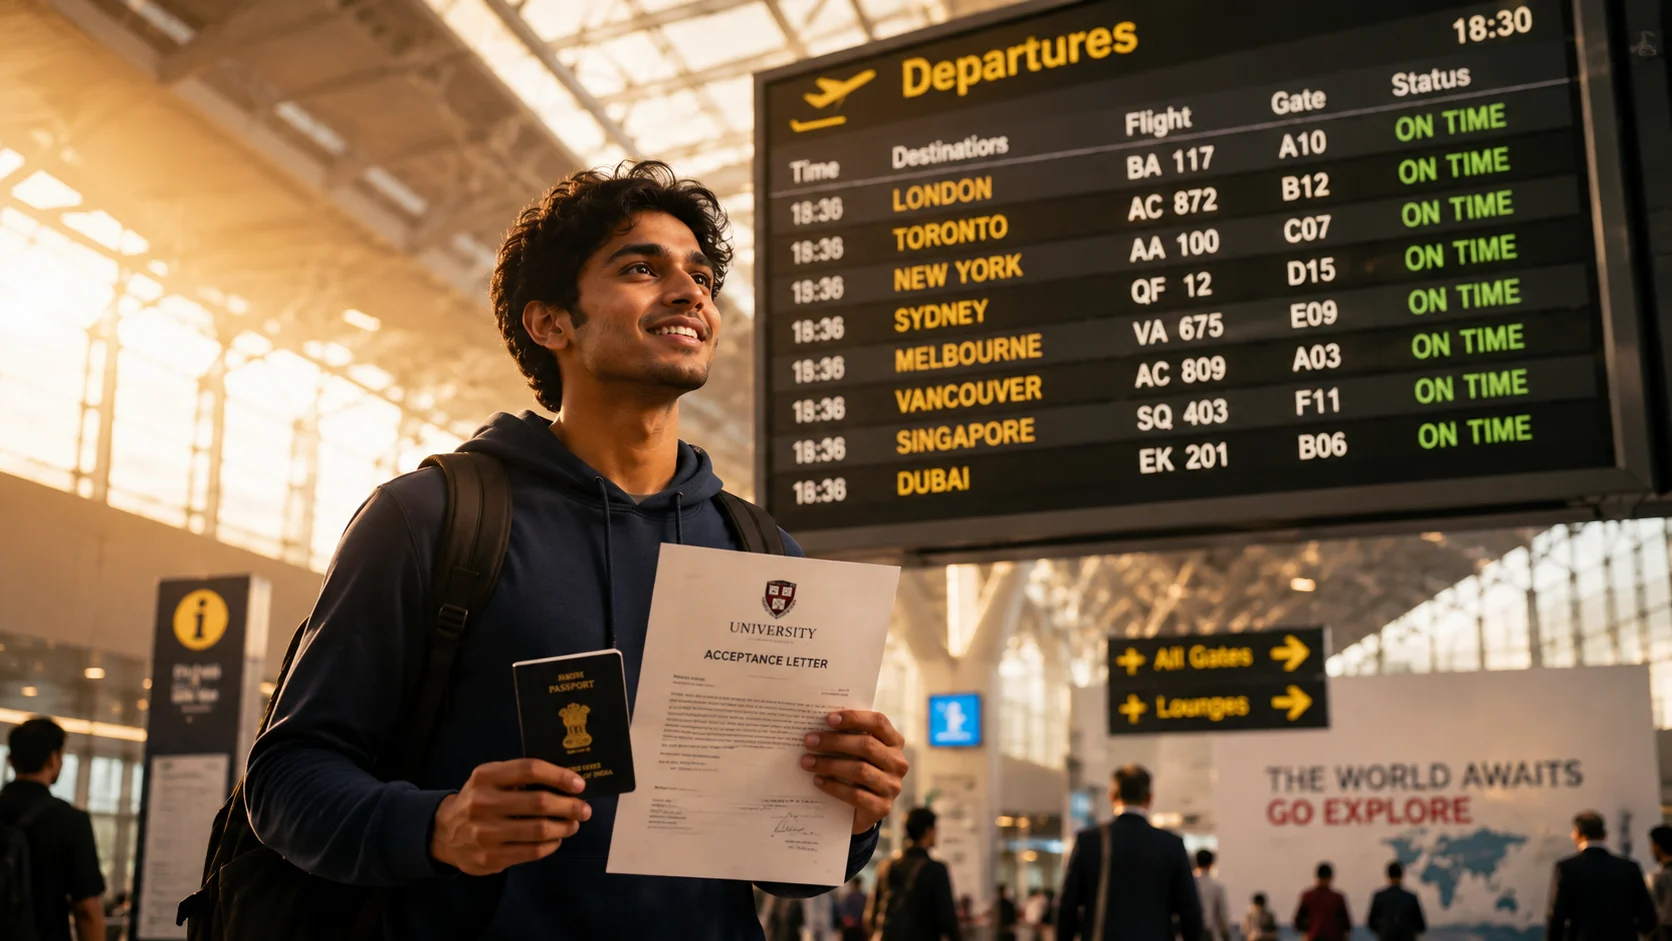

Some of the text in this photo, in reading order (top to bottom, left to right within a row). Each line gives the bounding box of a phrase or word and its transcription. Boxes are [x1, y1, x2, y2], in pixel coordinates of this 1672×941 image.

[902, 21, 1138, 98] Departures
[1453, 6, 1532, 43] 18:30
[790, 160, 839, 182] Time
[1126, 107, 1192, 137] Flight
[1272, 89, 1326, 114] Gate
[1392, 68, 1471, 96] Status
[893, 176, 992, 212] LONDON
[1127, 154, 1161, 179] BA
[1173, 145, 1214, 173] 117
[1279, 130, 1326, 158] A10
[1396, 114, 1433, 141] ON
[1442, 103, 1506, 134] TIME
[893, 215, 1008, 251] TORONTO
[1128, 194, 1163, 221] AC
[1174, 187, 1217, 215] 872
[1282, 172, 1329, 201] B12
[1399, 157, 1437, 184] ON
[1446, 147, 1510, 177] TIME
[895, 263, 948, 291] NEW
[955, 254, 1023, 283] YORK
[1130, 236, 1166, 262] AA
[1177, 229, 1219, 256] 100
[1284, 215, 1331, 243] C07
[1402, 200, 1440, 227] ON
[1448, 190, 1513, 221] TIME
[895, 299, 988, 332] SYDNEY
[1131, 277, 1165, 304] QF
[1184, 272, 1212, 297] 12
[1288, 257, 1335, 285] D15
[1405, 244, 1443, 271] ON
[1453, 234, 1517, 264] TIME
[896, 334, 1042, 372] MELBOURNE
[1133, 319, 1168, 345] VA
[1179, 313, 1223, 340] 675
[1291, 300, 1337, 328] E09
[1409, 287, 1447, 314] ON
[1456, 279, 1521, 308] TIME
[895, 375, 1042, 413] VANCOUVER
[1135, 361, 1170, 388] AC
[1182, 356, 1226, 383] 809
[1293, 343, 1341, 372] A03
[1412, 332, 1450, 359] ON
[1460, 324, 1524, 353] TIME
[897, 418, 1035, 454] SINGAPORE
[1137, 404, 1172, 430] SQ
[1183, 399, 1228, 425] 403
[1296, 388, 1339, 416] F11
[1415, 377, 1453, 403] ON
[1463, 369, 1528, 398] TIME
[898, 467, 969, 495] DUBAI
[1140, 447, 1174, 473] EK
[1186, 442, 1227, 469] 201
[1299, 432, 1347, 460] B06
[1419, 422, 1457, 449] ON
[1467, 415, 1532, 444] TIME
[704, 650, 829, 669] ACCEPTANCE LETTER
[730, 622, 816, 639] UNIVERSITY
[1155, 645, 1252, 669] All Gates
[549, 680, 595, 694] PASSPORT
[1156, 696, 1249, 721] Lounges
[1267, 759, 1584, 792] THE WORLD AWAITS
[1267, 796, 1472, 827] GO EXPLORE
